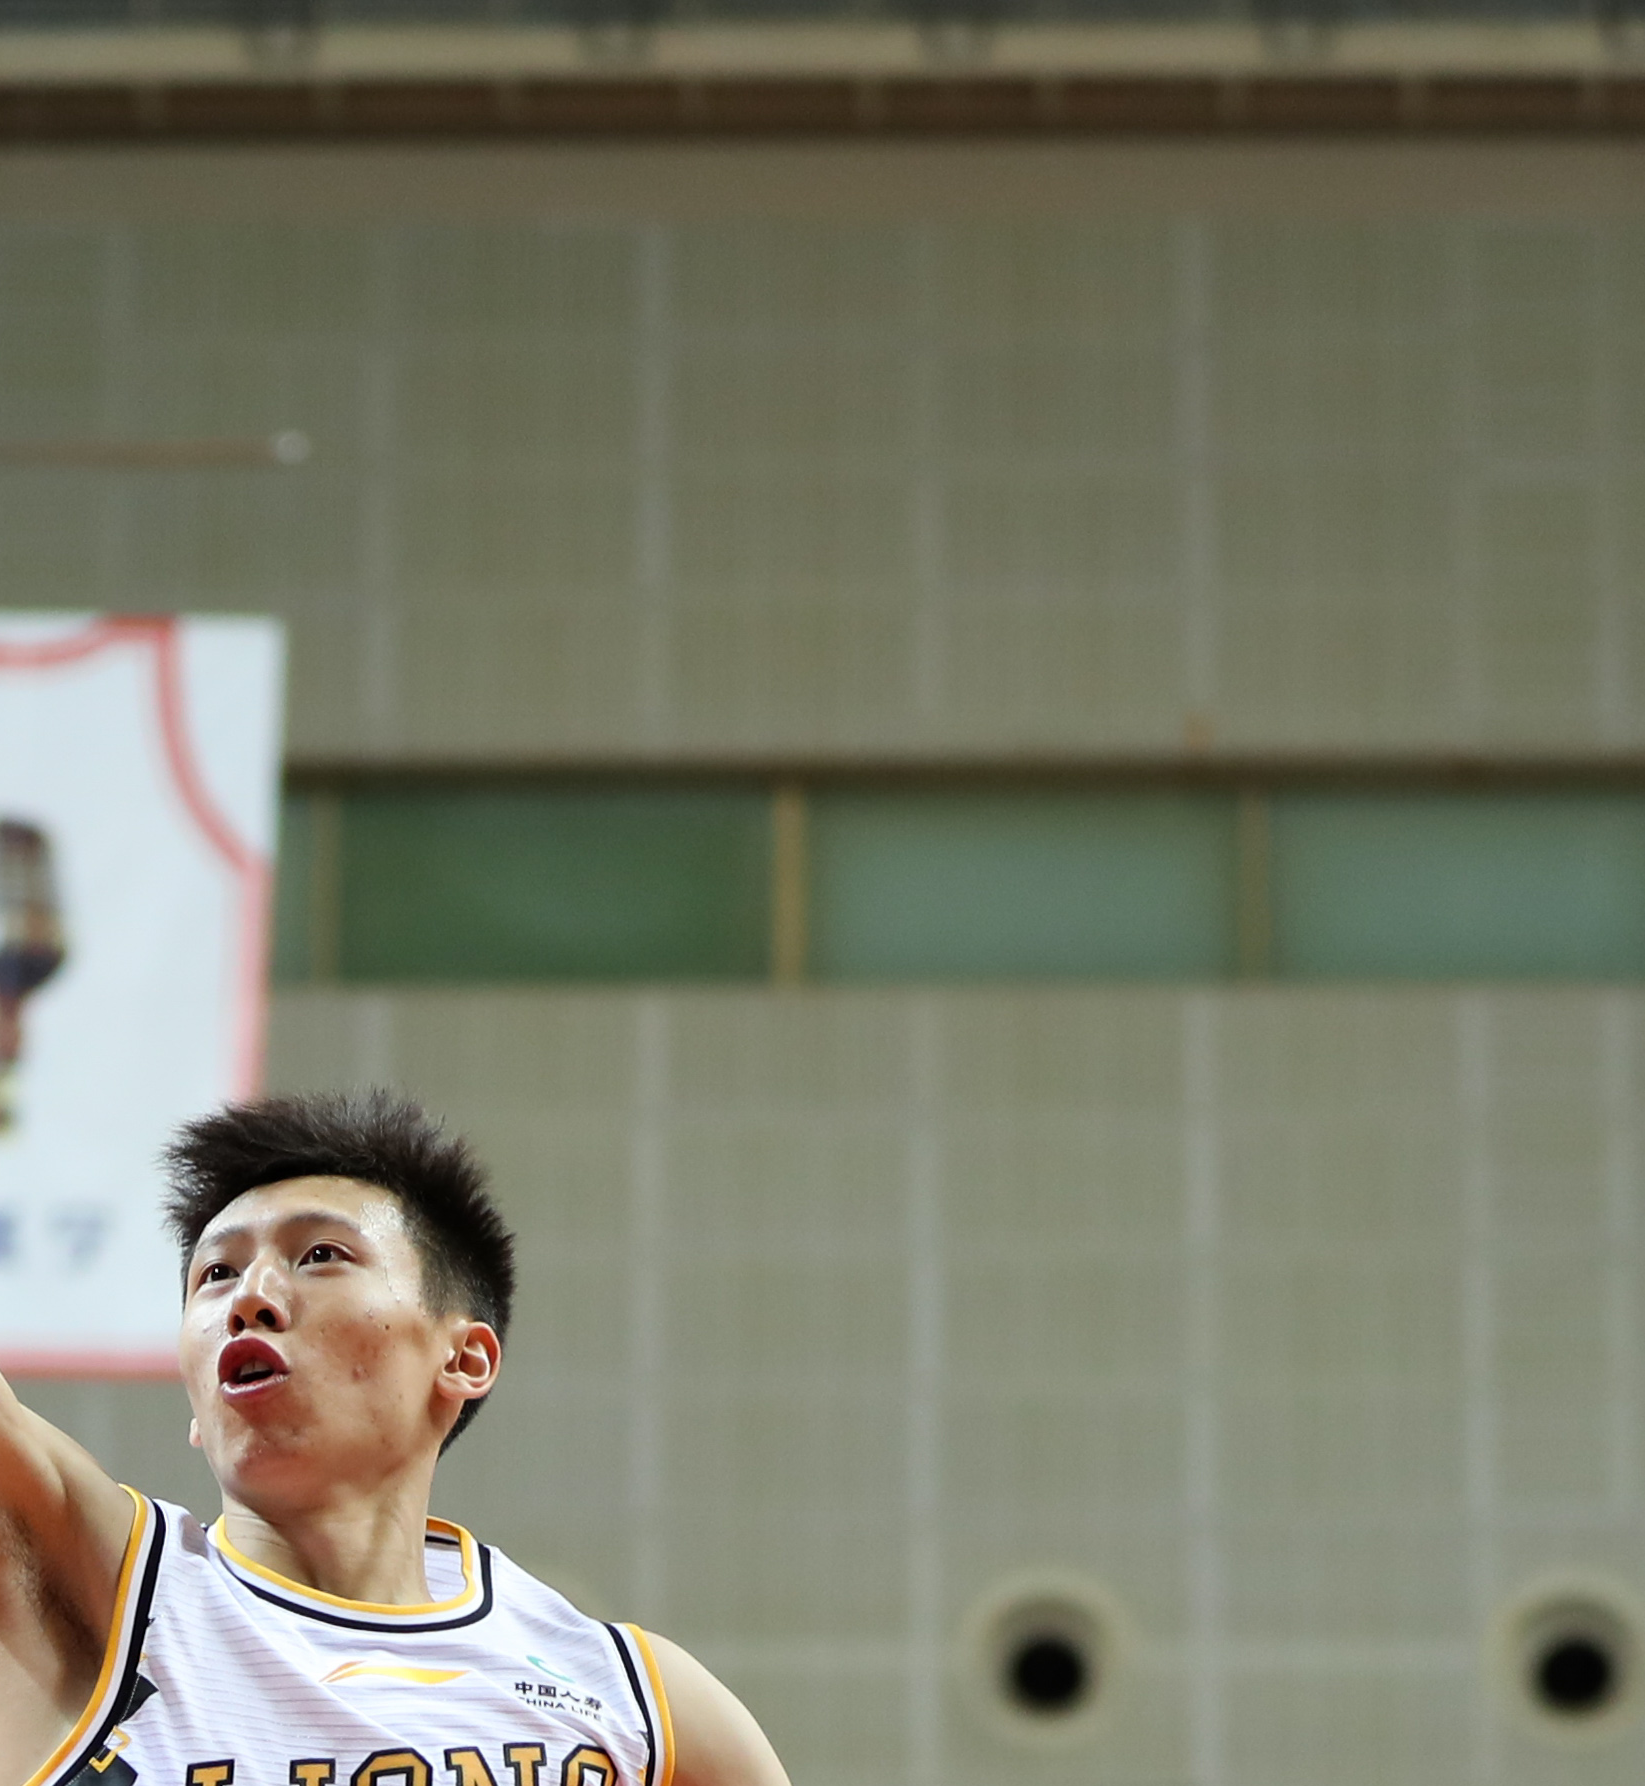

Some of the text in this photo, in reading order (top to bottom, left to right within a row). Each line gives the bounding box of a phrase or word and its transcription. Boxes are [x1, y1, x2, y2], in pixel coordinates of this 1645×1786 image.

[514, 1681, 603, 1711] 中国人寿
[518, 1696, 602, 1721] HINA LIFE
